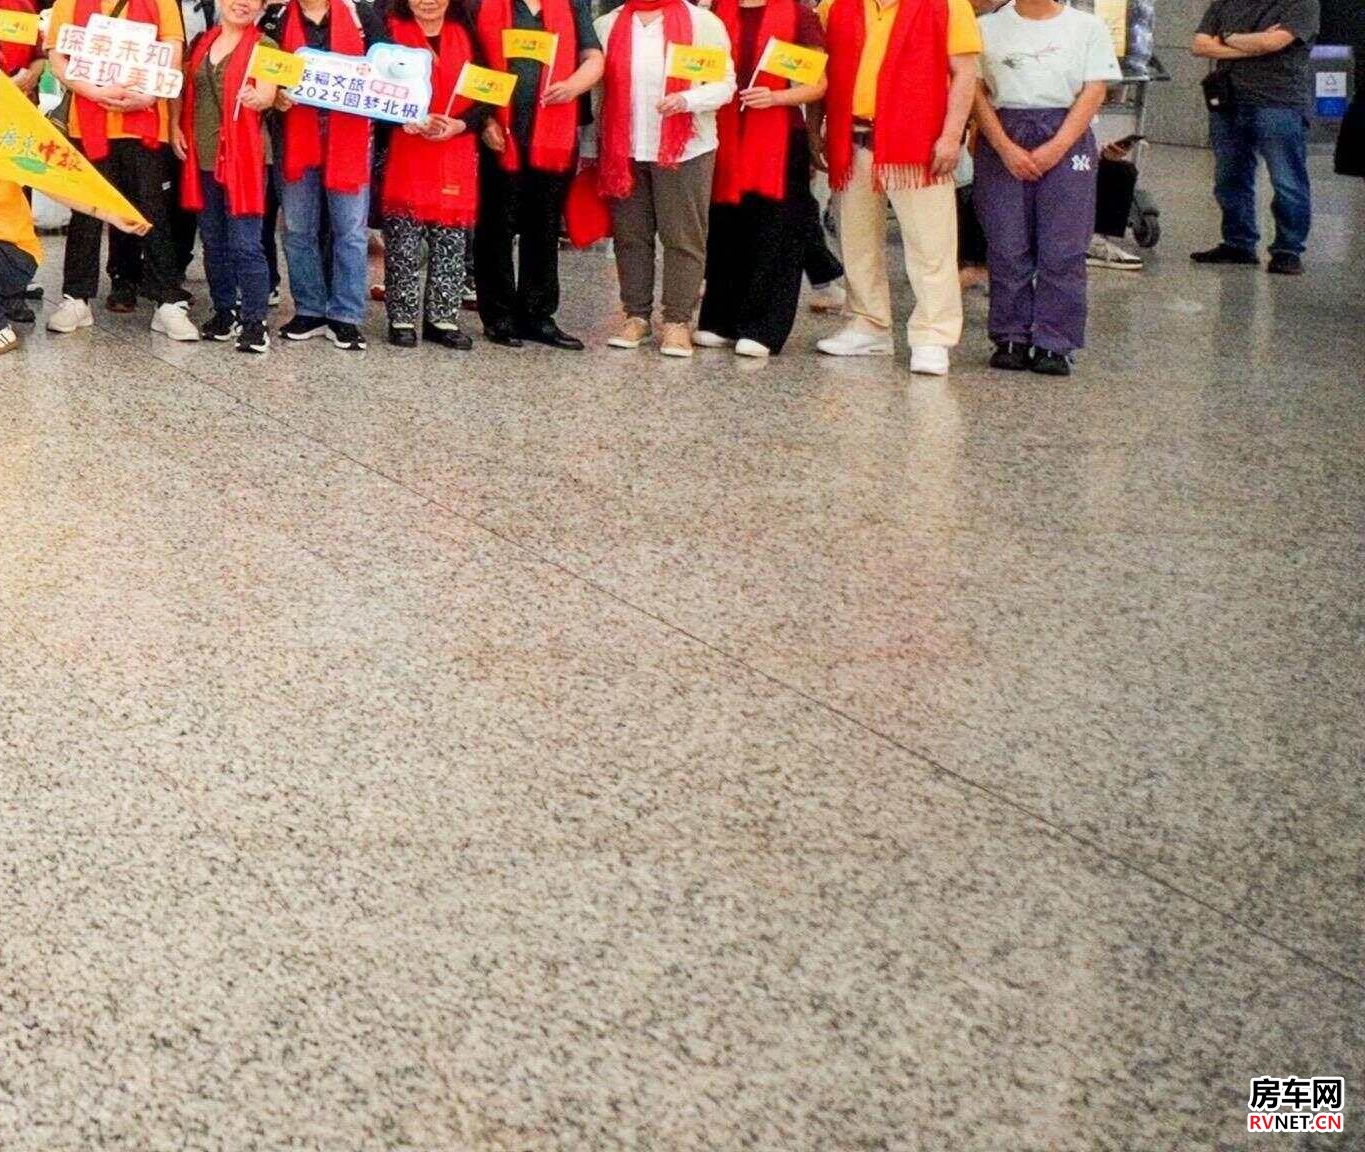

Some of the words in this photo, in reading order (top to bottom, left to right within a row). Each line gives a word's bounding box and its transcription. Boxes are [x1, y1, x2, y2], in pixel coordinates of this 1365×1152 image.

[61, 29, 170, 67] 探索未知
[70, 57, 179, 95] 发现美好
[294, 85, 419, 118] 2025圆梦北极
